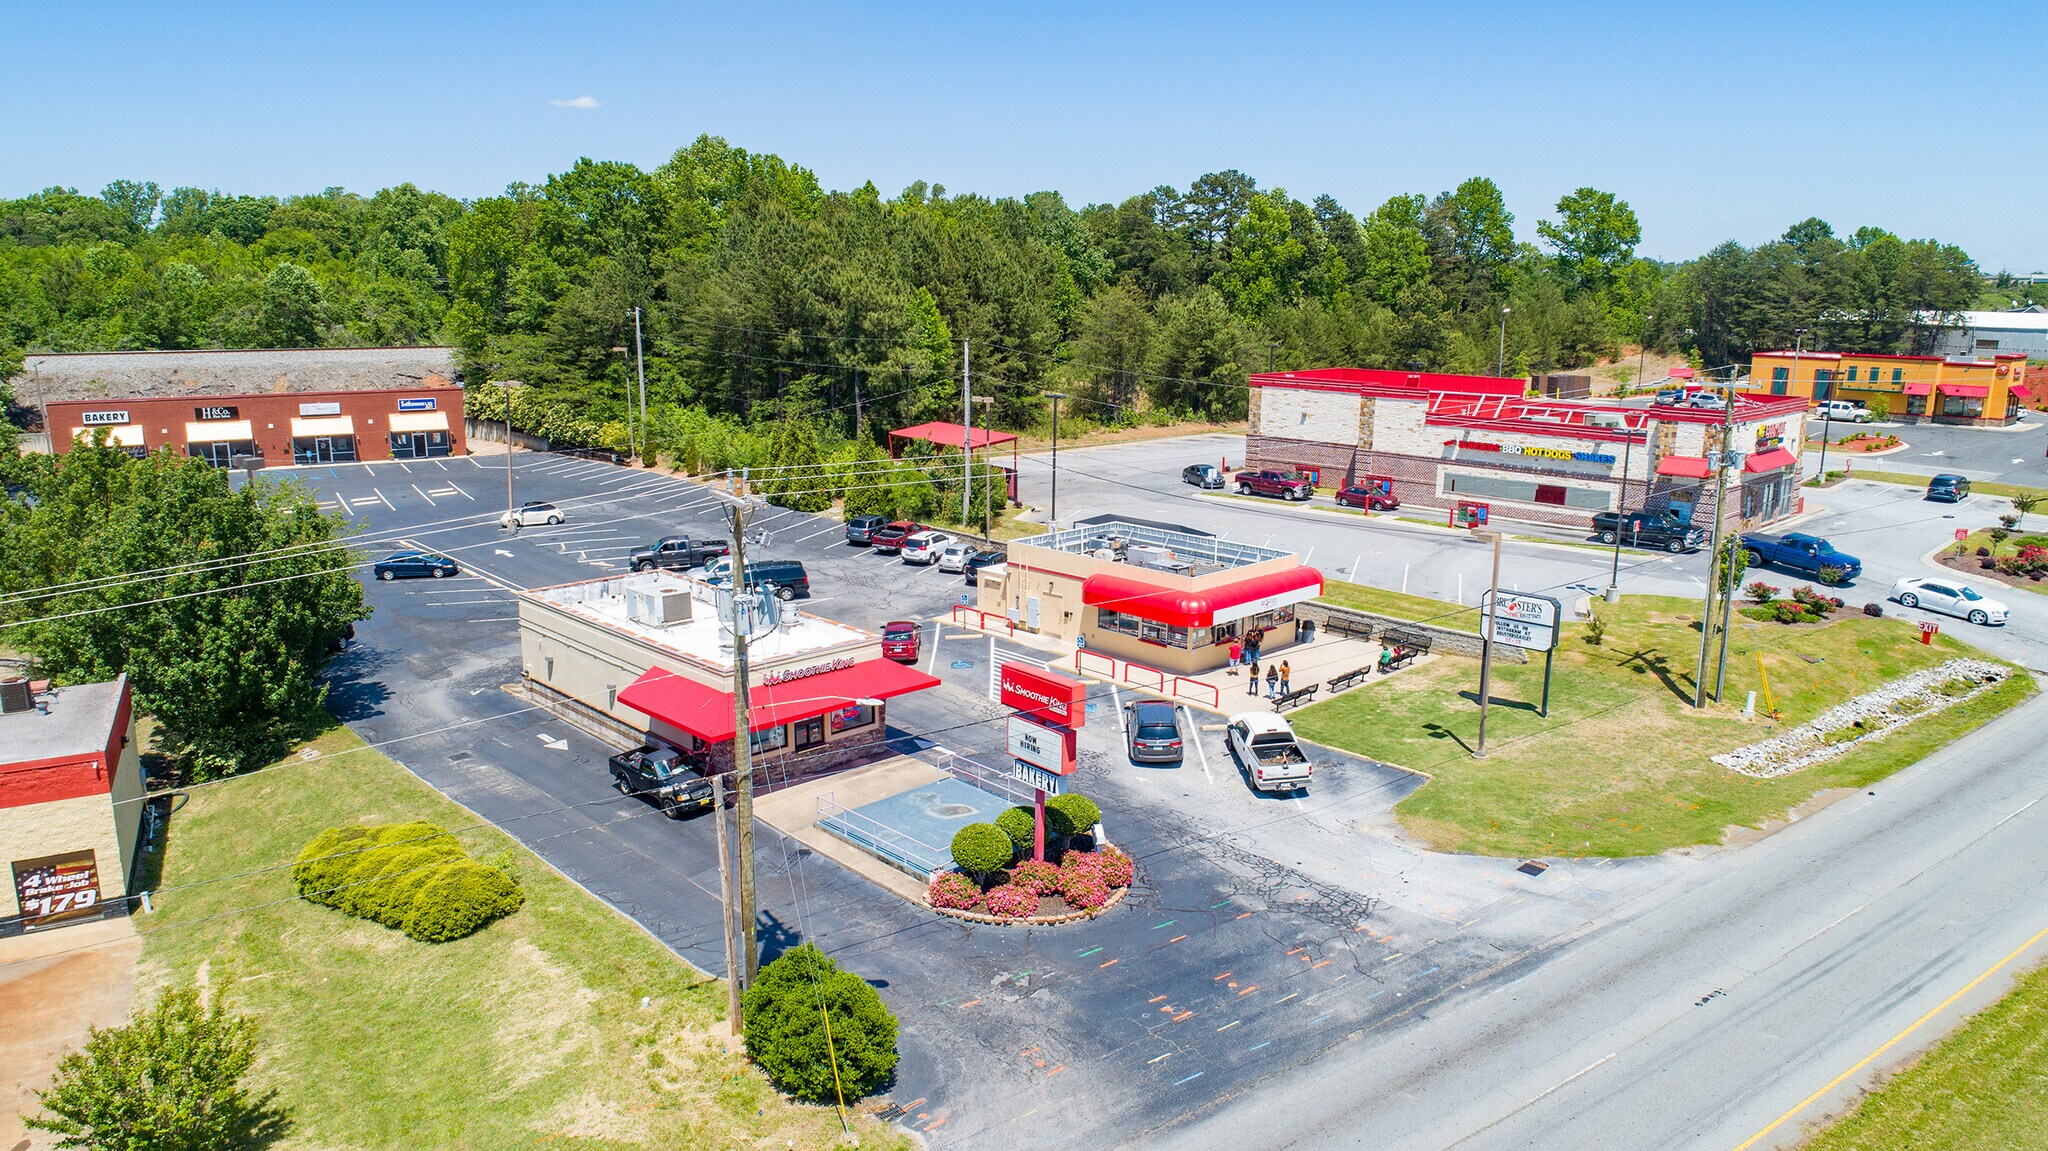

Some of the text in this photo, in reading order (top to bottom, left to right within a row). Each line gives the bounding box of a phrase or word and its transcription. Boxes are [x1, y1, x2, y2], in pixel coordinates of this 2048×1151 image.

[84, 412, 126, 422] BAKERY
[1458, 440, 1615, 464] BURGERS BBQ HOT DOGS SHAKES
[1918, 622, 1938, 633] EXIT
[782, 665, 832, 682] SMOOTHIE
[1015, 684, 1050, 705] SMOOTHIE
[1020, 739, 1041, 755] HIRING
[1024, 733, 1038, 745] NOW
[1015, 761, 1057, 794] BAKERY
[23, 870, 90, 888] 4 Wheel
[25, 880, 90, 896] Brake Job
[25, 889, 97, 915] $179
